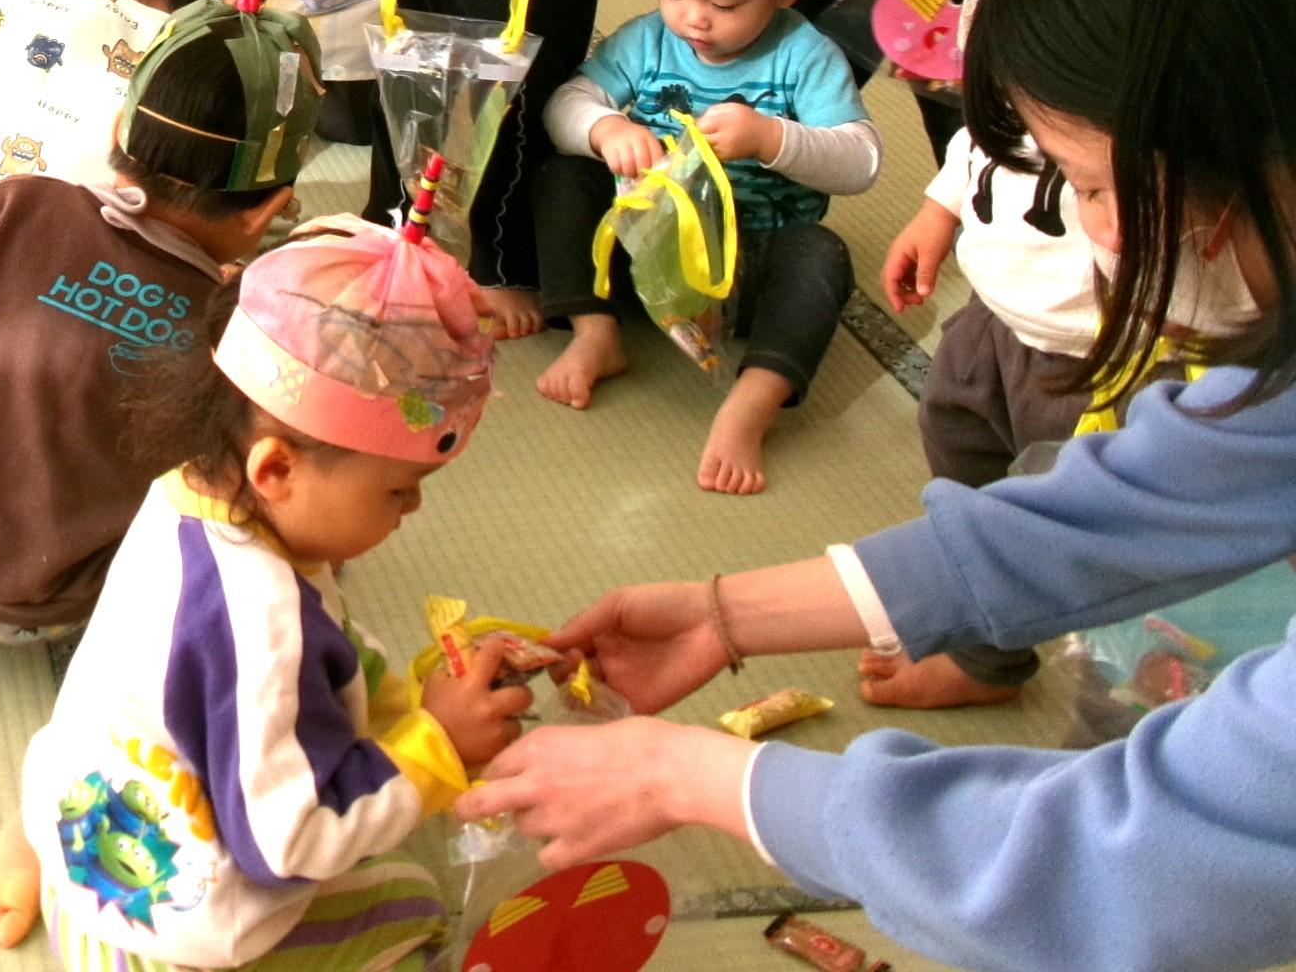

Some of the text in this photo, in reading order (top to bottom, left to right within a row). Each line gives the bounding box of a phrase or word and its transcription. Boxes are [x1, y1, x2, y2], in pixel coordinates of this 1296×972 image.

[49, 274, 195, 352] HOT DOG
[87, 260, 192, 319] DOG'S
